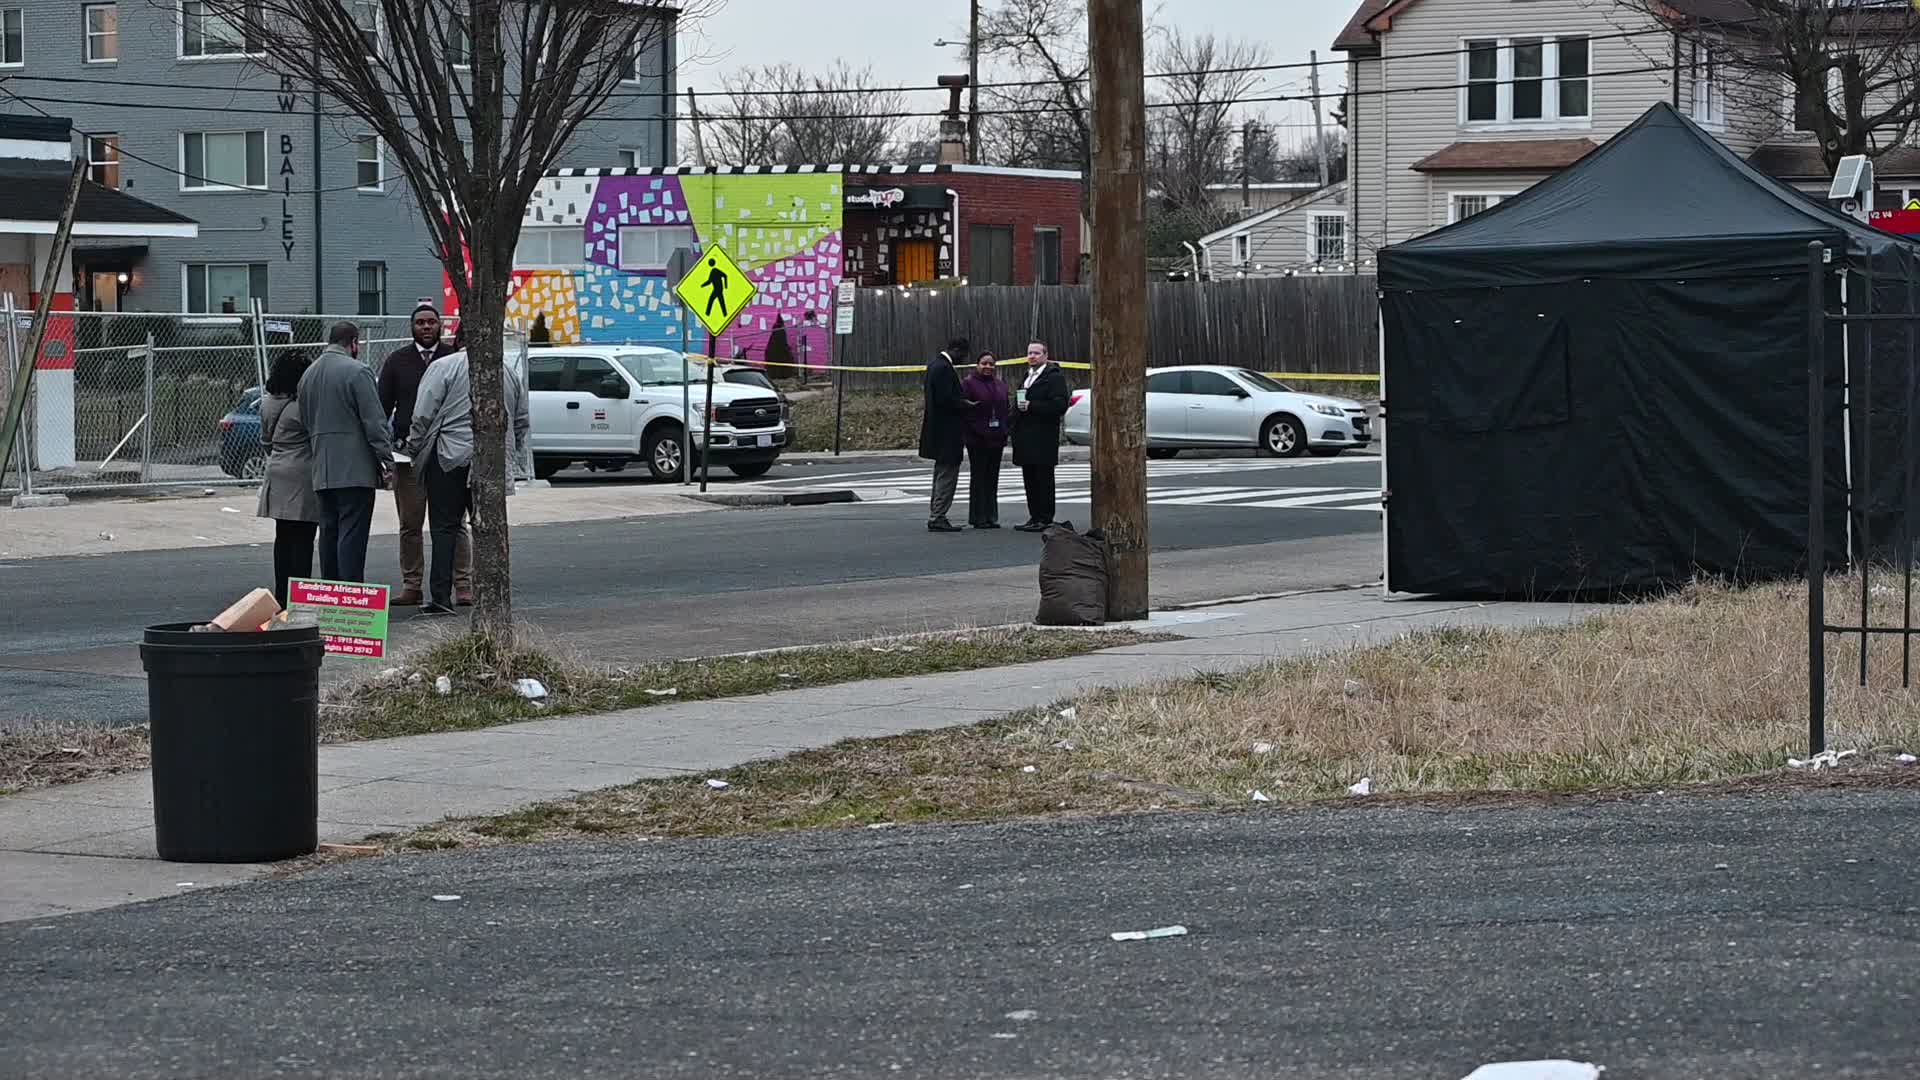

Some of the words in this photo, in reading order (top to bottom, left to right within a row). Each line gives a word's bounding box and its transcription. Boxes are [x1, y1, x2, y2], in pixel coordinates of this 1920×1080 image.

[280, 134, 295, 262] BAILEY
[1870, 211, 1880, 219] V2
[333, 584, 361, 594] African
[363, 586, 378, 595] Hair
[307, 593, 338, 604] Braiding
